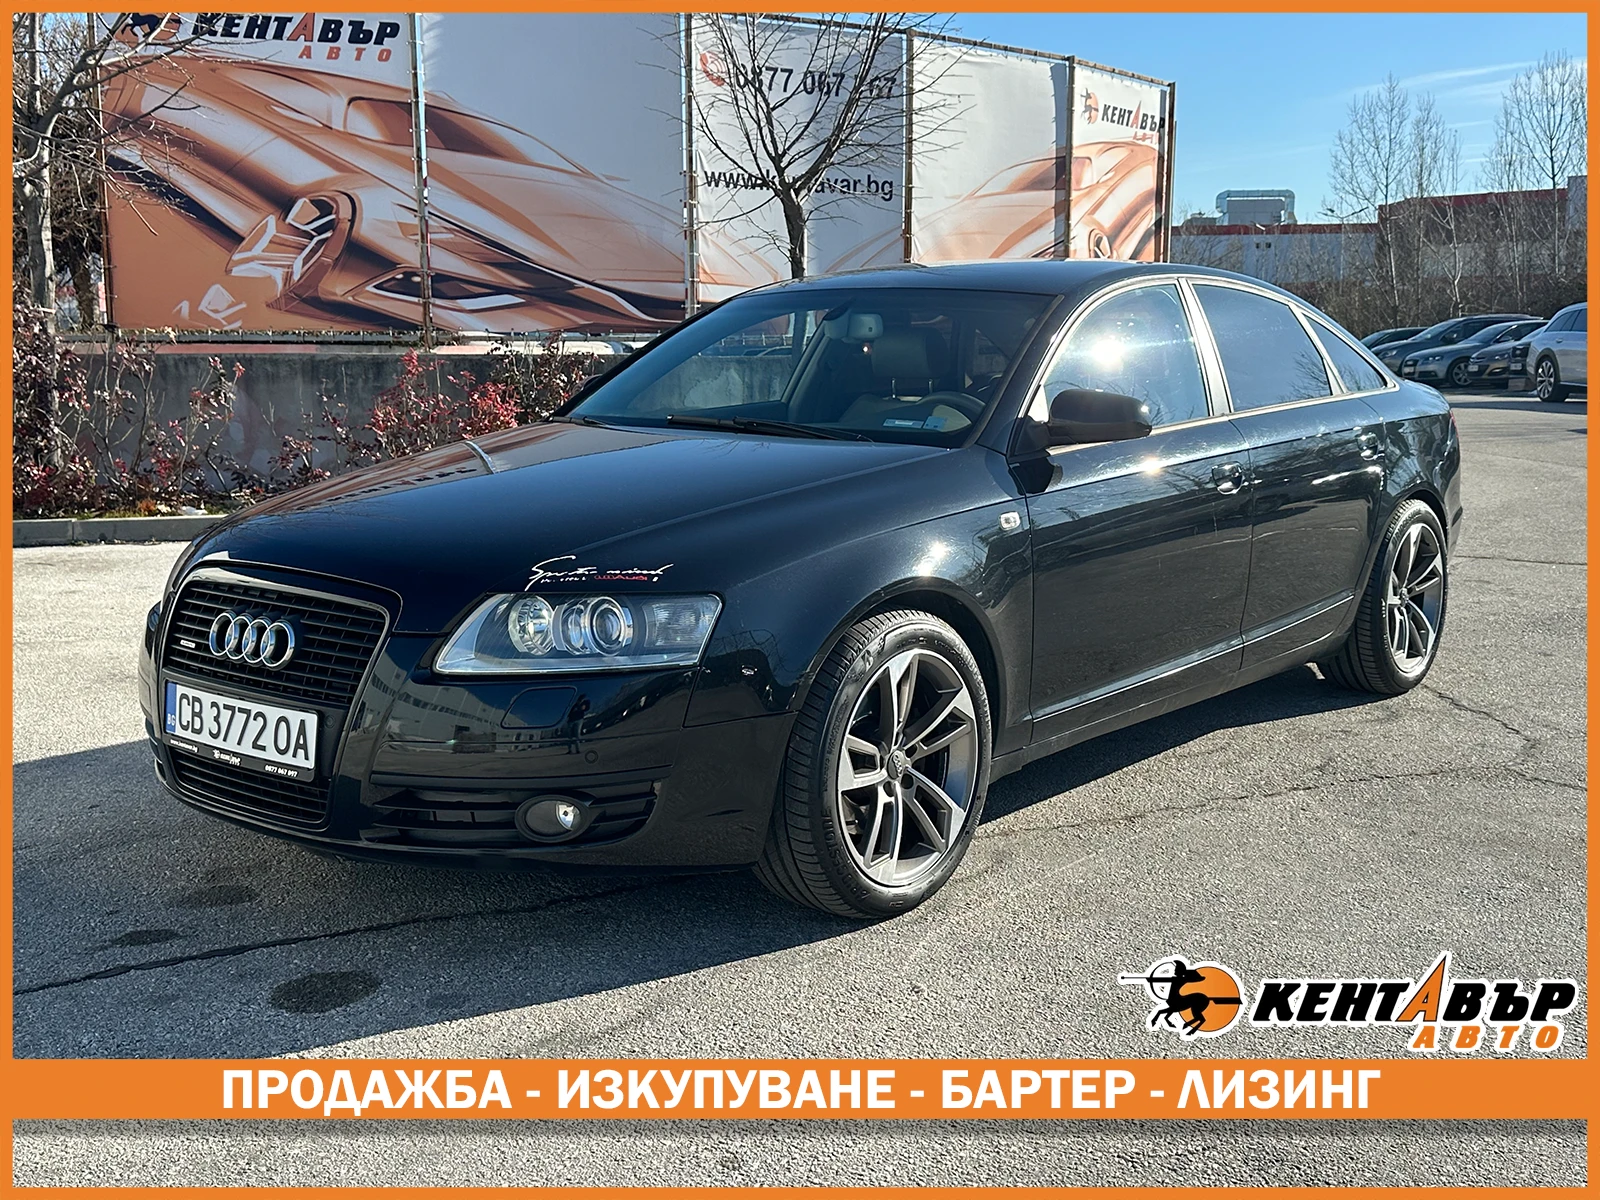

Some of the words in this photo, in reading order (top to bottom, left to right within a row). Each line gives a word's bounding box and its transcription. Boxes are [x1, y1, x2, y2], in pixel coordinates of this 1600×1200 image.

[191, 13, 400, 45] КЕНТАВЪР
[298, 45, 392, 62] АВТО
[735, 63, 793, 92] 0877
[1101, 100, 1166, 133] КЕНТАВЪР
[704, 169, 894, 202] www.kavar.bg
[167, 713, 176, 726] BG
[178, 692, 204, 735] CB
[208, 701, 268, 752] 3772
